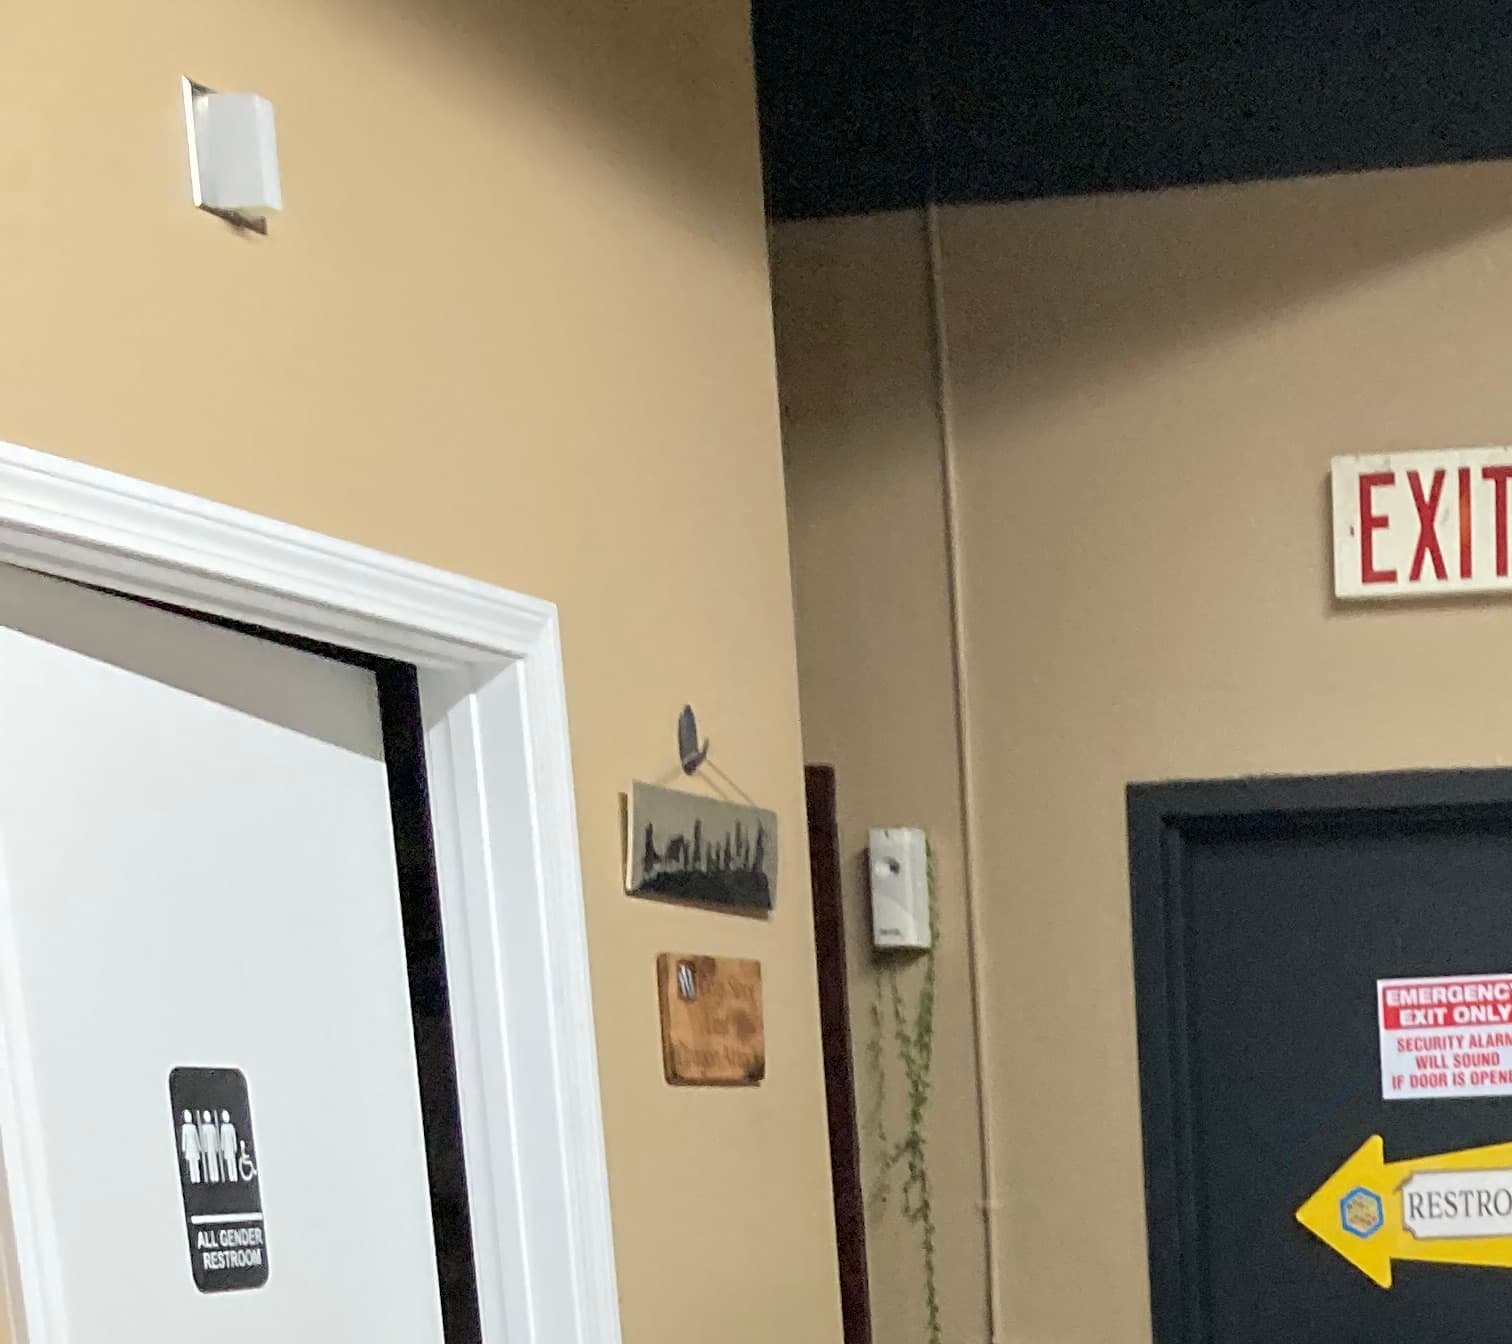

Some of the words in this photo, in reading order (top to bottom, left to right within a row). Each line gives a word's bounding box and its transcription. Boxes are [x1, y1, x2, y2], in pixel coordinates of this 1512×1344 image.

[1400, 1007, 1448, 1026] EXIT
[1453, 1003, 1512, 1023] ONLY
[1397, 1034, 1464, 1053] SECURITY
[1415, 1053, 1449, 1070] WILL
[1453, 1052, 1501, 1068] SOUND
[1392, 1074, 1405, 1090] IF
[1410, 1072, 1448, 1088] DOOR
[1452, 1071, 1465, 1086] IS
[197, 1230, 218, 1249] ALL
[219, 1227, 263, 1248] GENDER
[203, 1248, 263, 1270] RESTROOM
